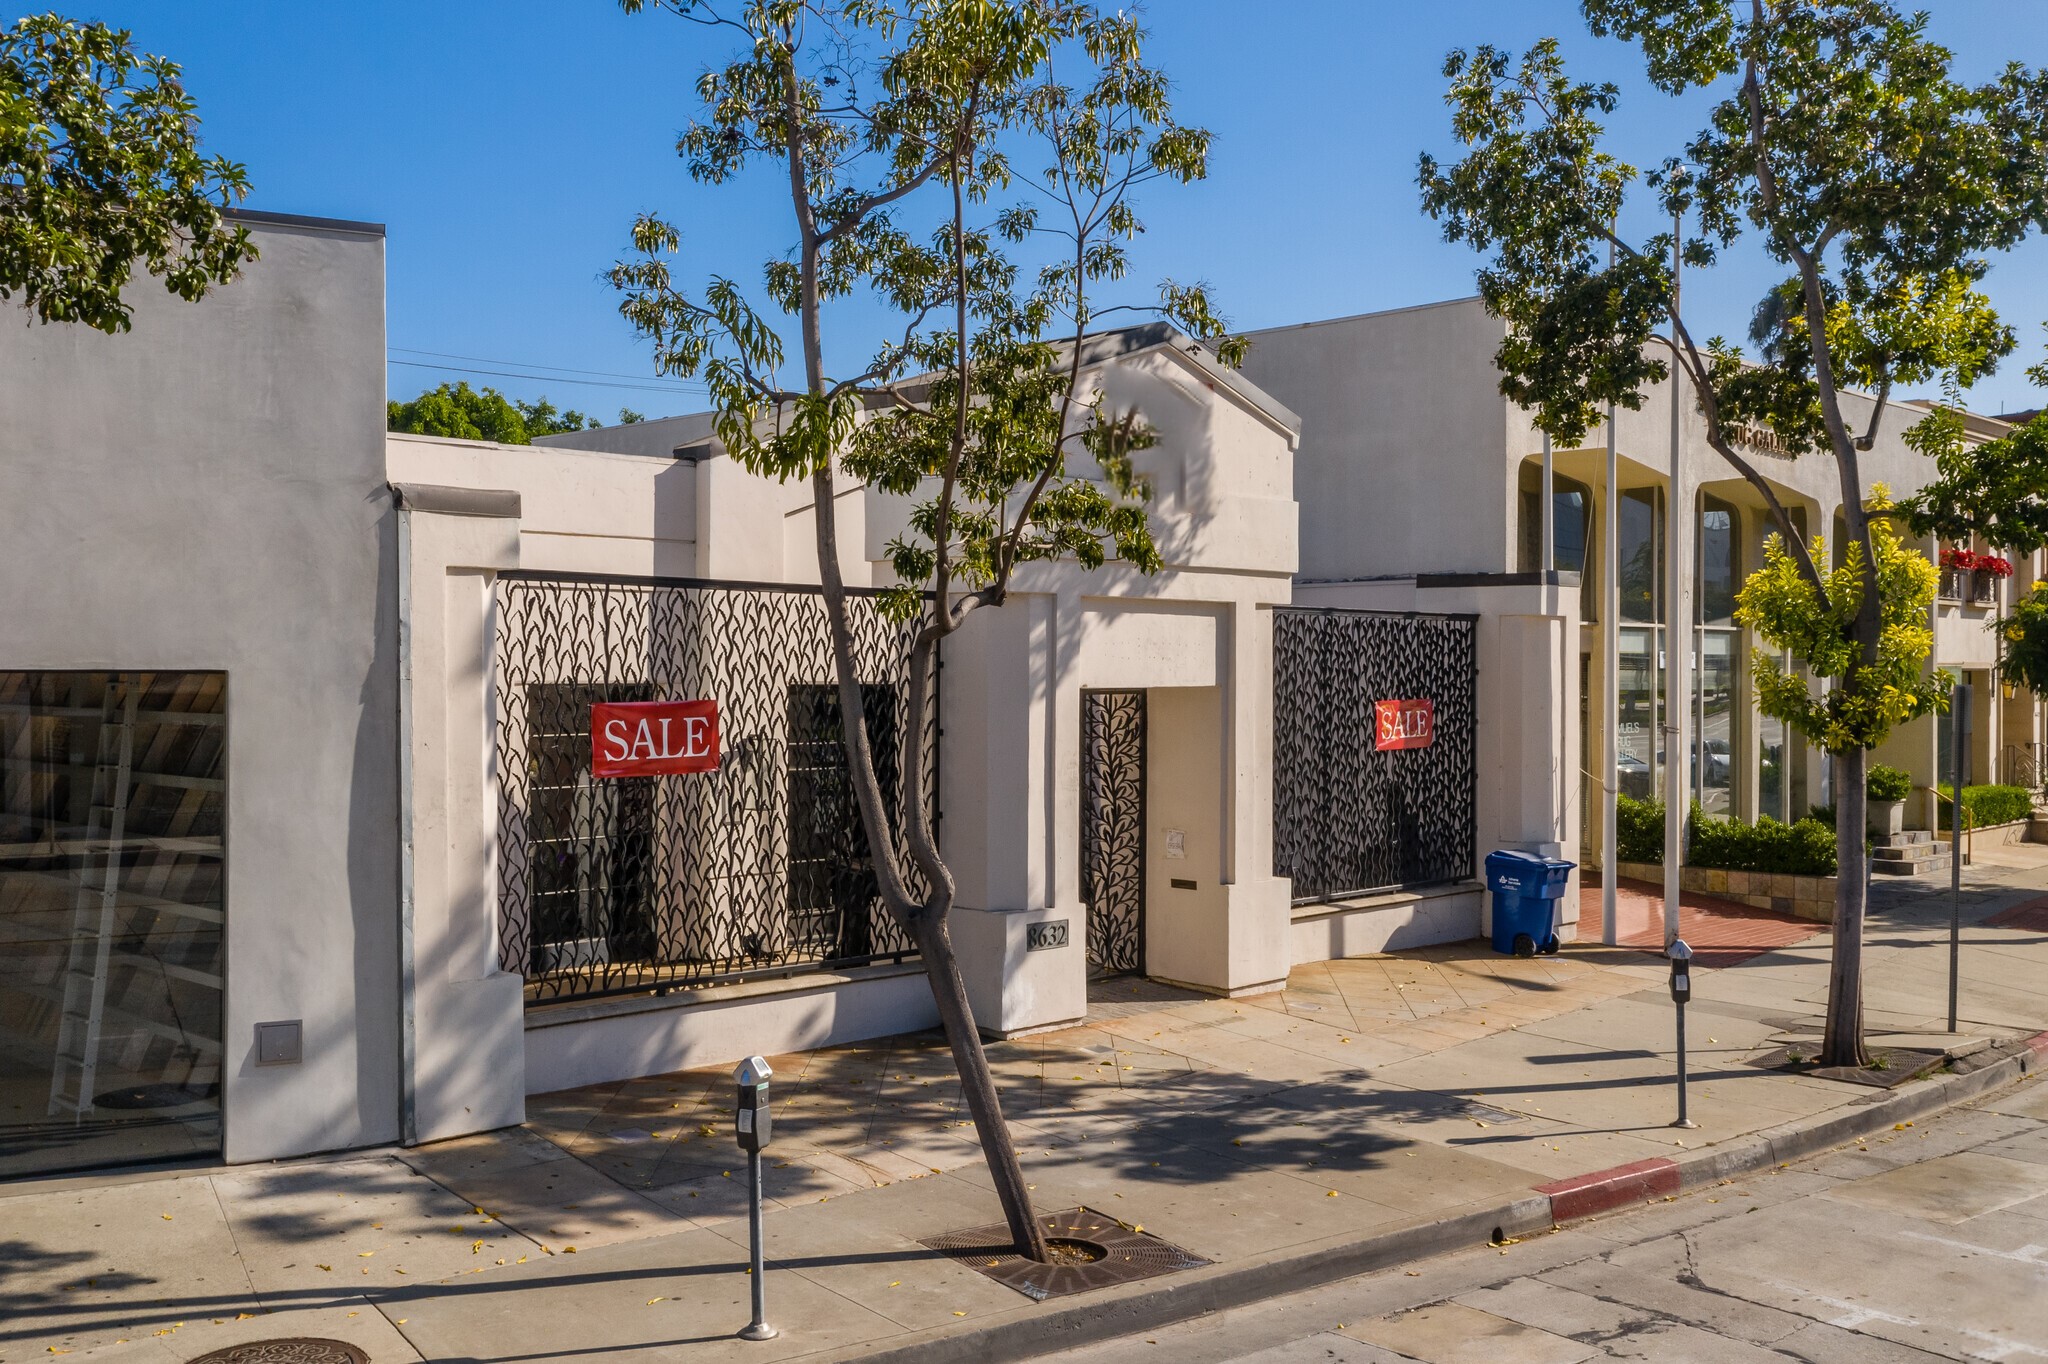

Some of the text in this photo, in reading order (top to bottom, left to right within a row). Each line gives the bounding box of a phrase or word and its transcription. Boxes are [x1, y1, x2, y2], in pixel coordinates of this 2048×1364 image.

[1756, 429, 1791, 453] GALL
[1381, 710, 1429, 740] SALE
[604, 717, 710, 761] SALE
[1028, 924, 1066, 948] 8632
